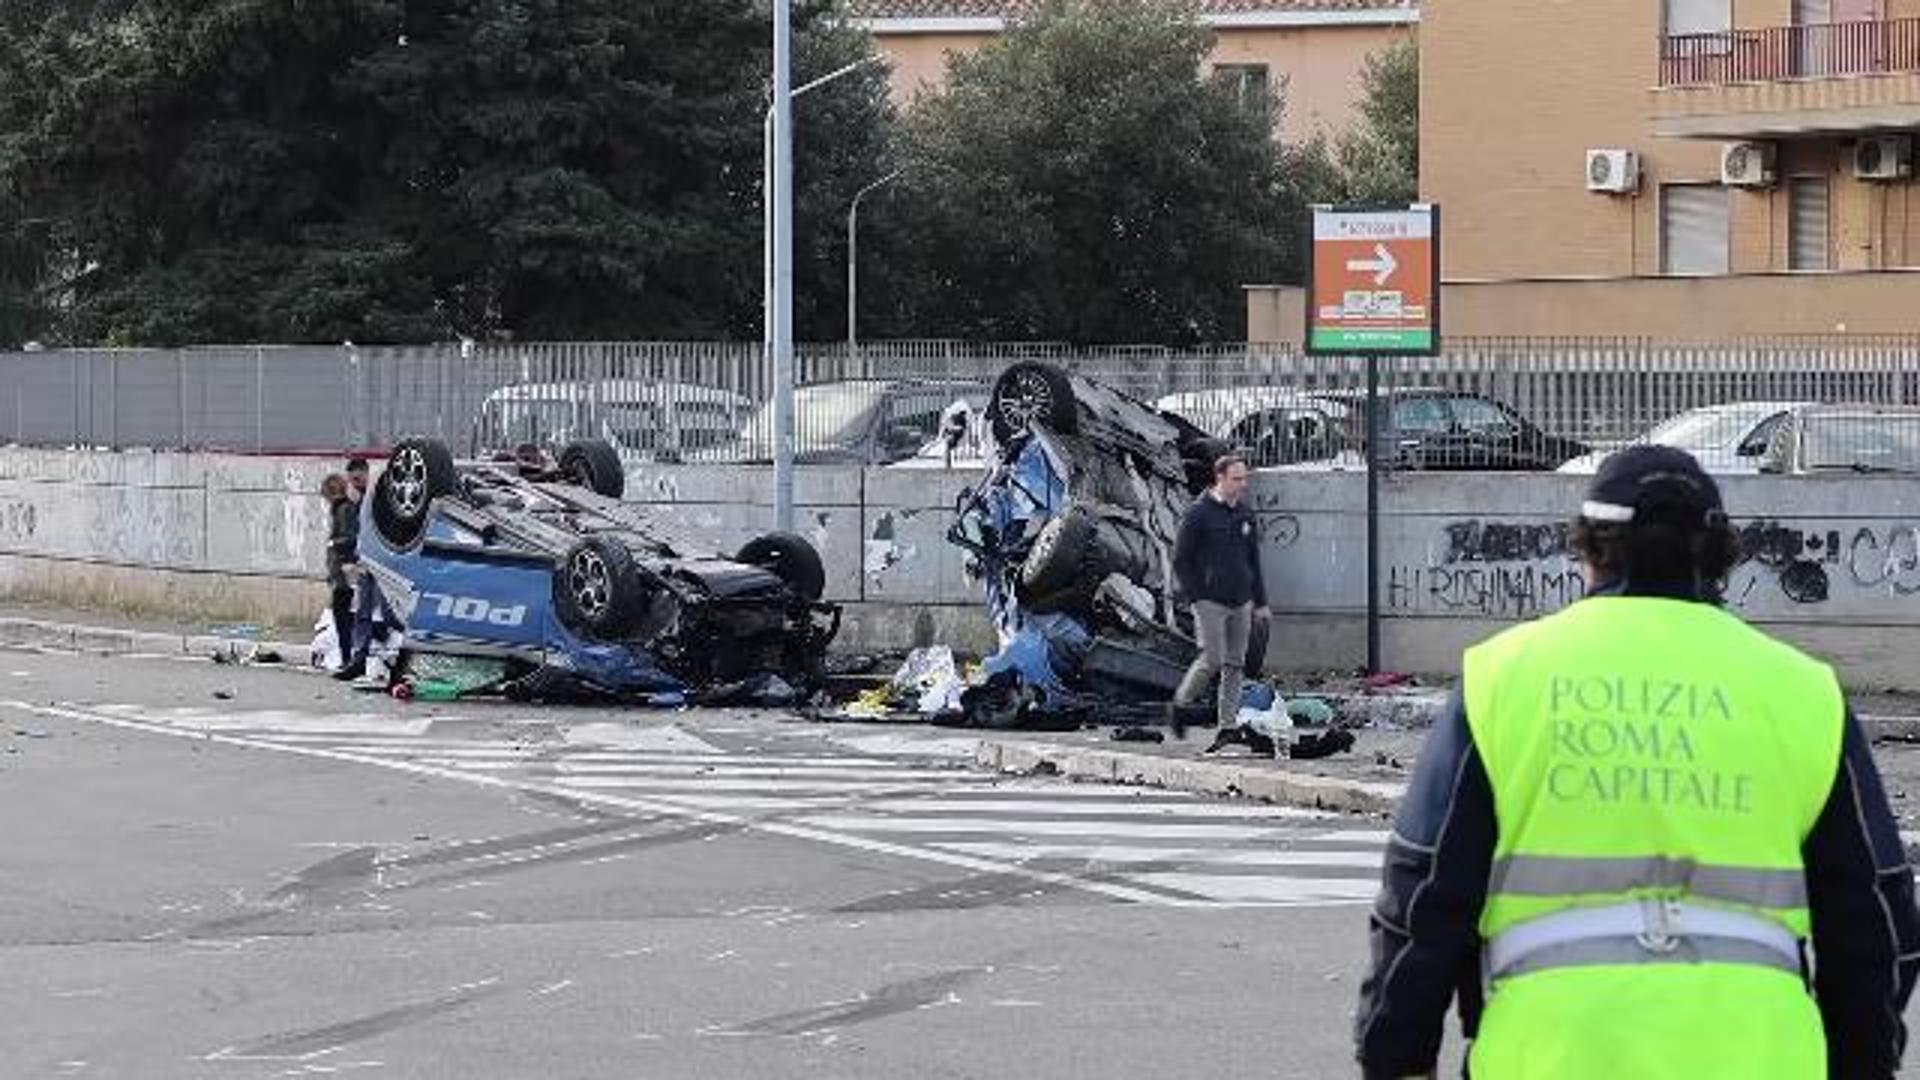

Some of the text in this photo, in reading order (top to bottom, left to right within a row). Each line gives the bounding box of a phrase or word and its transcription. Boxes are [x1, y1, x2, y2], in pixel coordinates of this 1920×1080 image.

[1551, 675, 1731, 720] POLIZIA
[1552, 719, 1695, 762] ROMA
[1549, 764, 1753, 813] CAPITALE
